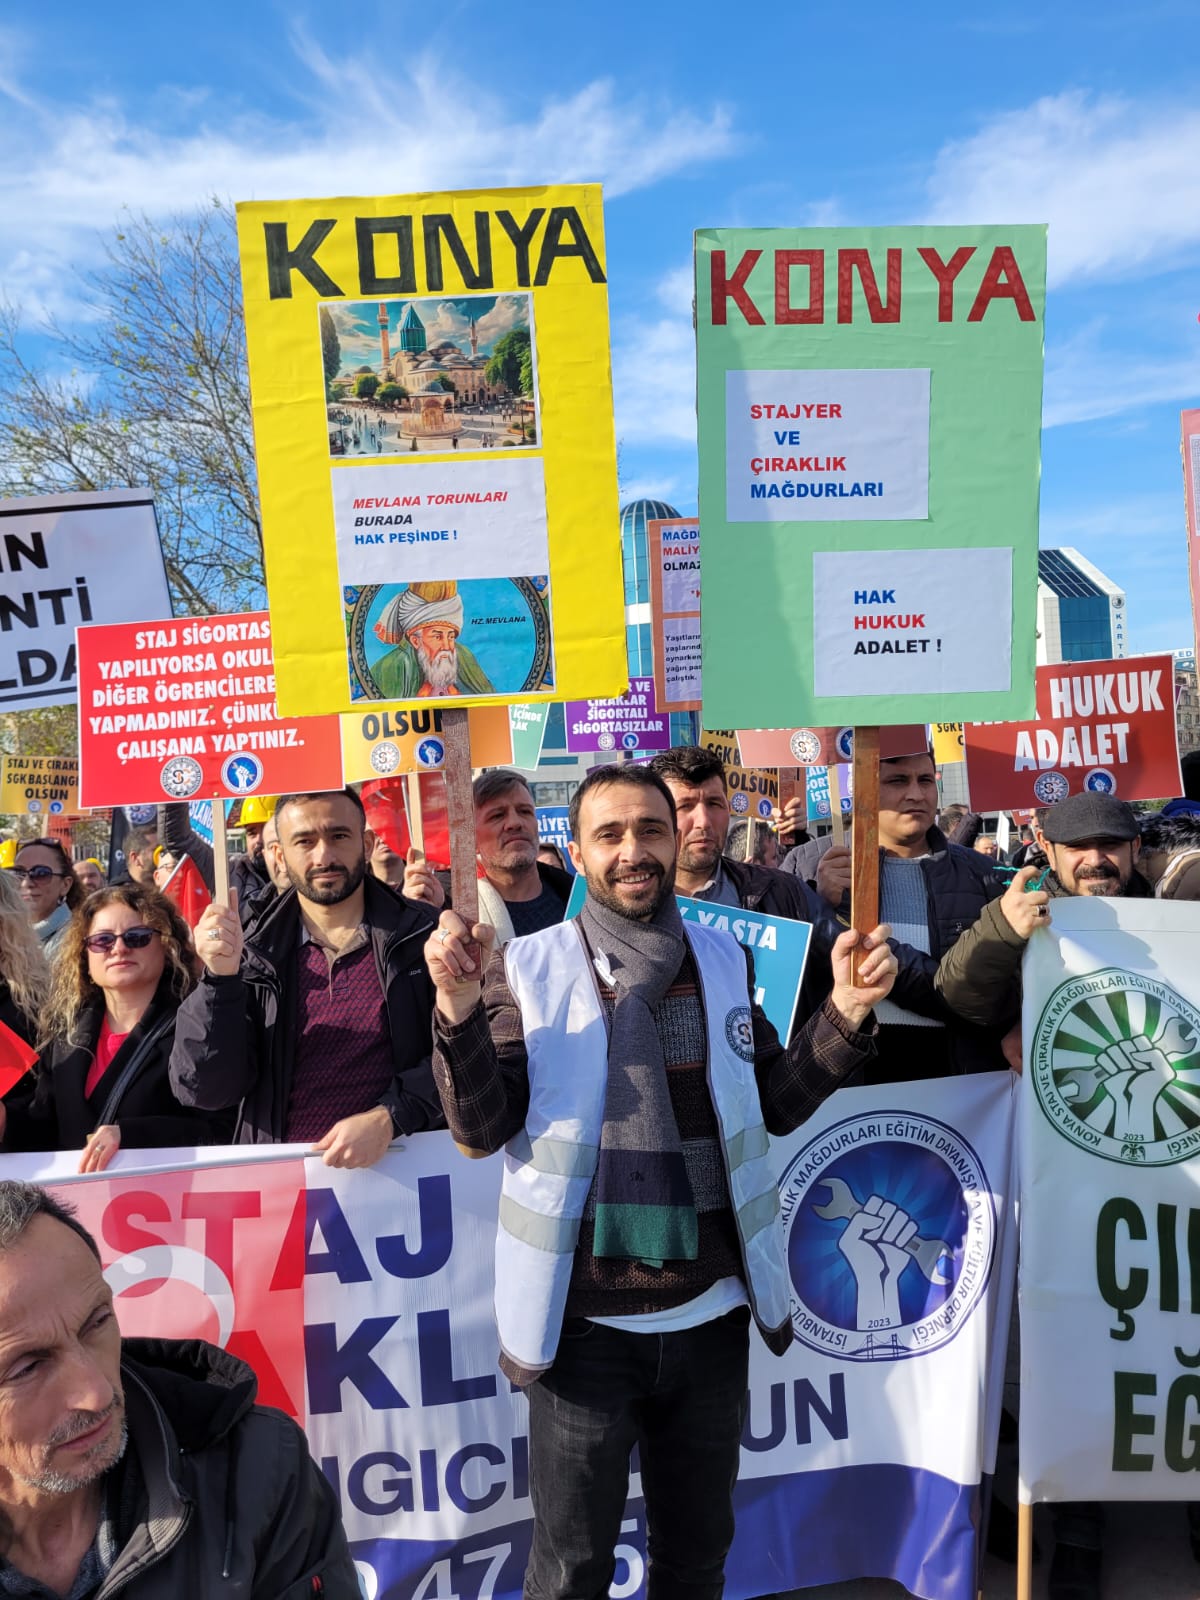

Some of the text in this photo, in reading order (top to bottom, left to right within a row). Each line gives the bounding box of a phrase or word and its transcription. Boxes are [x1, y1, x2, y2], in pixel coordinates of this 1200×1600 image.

[264, 206, 607, 299] KONYA
[710, 246, 1036, 325] KONYA
[750, 404, 842, 419] STAJYER
[774, 431, 800, 445] VE
[750, 456, 847, 475] ÇIRAKLIK
[750, 480, 884, 498] MAĞDURLARI
[353, 491, 508, 509] MEVLANA TORUNLARI
[354, 514, 413, 527] BURADA
[354, 534, 385, 545] HAK
[389, 529, 449, 544] PEŞİNDE
[854, 590, 896, 604] HAK
[854, 614, 925, 629] HUKUK
[135, 629, 177, 650] STAJ
[854, 640, 930, 655] ADALET
[98, 652, 218, 680] YAPILIYORSA
[92, 683, 149, 708] DİĞER
[635, 681, 650, 692] VE
[1050, 670, 1165, 719] HUKUK
[89, 708, 217, 735] YAPMADINIZ.
[587, 706, 648, 720] SİGORTALI
[572, 720, 663, 735] SİGORTASIZLAR
[117, 728, 305, 764] ÇALIŞANA YAPTINIZ.
[1014, 722, 1130, 772] ADALET
[7, 758, 29, 769] STAJ
[32, 760, 43, 769] VE
[7, 773, 27, 784] SGK
[728, 771, 779, 798] OLSUN
[25, 788, 68, 800] OLSUN
[1052, 975, 1127, 1015] MAĞDURLARI
[1038, 1016, 1057, 1070] ÇIRAKLIK
[1040, 1074, 1049, 1093] VE
[1063, 1114, 1102, 1146] KONYA
[1123, 1133, 1144, 1141] 2023
[794, 1123, 881, 1188] MAĞDURLARI
[886, 1120, 936, 1145] EĞİTİM
[102, 1174, 453, 1298] STAJ
[868, 1317, 891, 1329] 2023
